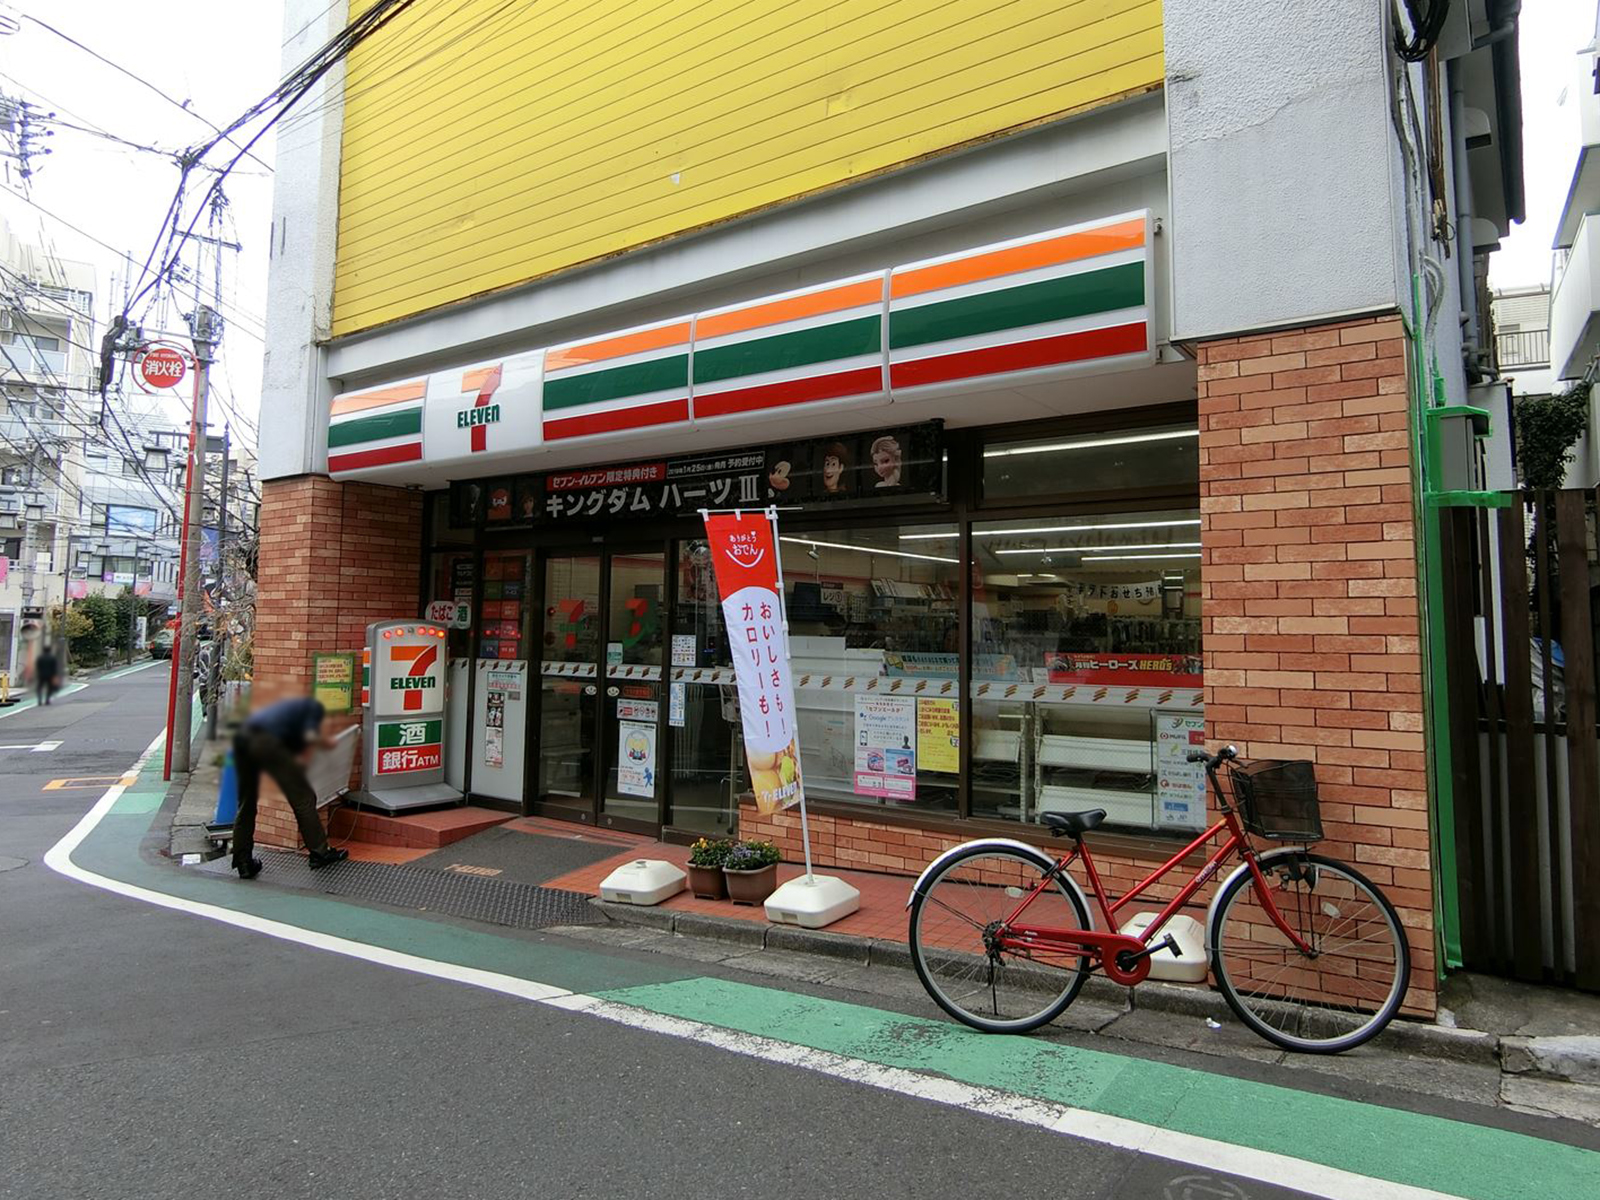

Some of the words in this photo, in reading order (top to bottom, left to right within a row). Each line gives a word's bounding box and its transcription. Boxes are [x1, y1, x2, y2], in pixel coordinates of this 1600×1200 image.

[145, 360, 183, 377] 消火栓
[461, 363, 503, 453] 7
[545, 486, 651, 519] キングダム
[659, 478, 733, 509] ハーツ
[732, 544, 758, 556] おでん
[431, 604, 453, 621] たばこ
[457, 605, 469, 622] 酒
[390, 644, 438, 711] 7
[399, 723, 427, 745] 酒
